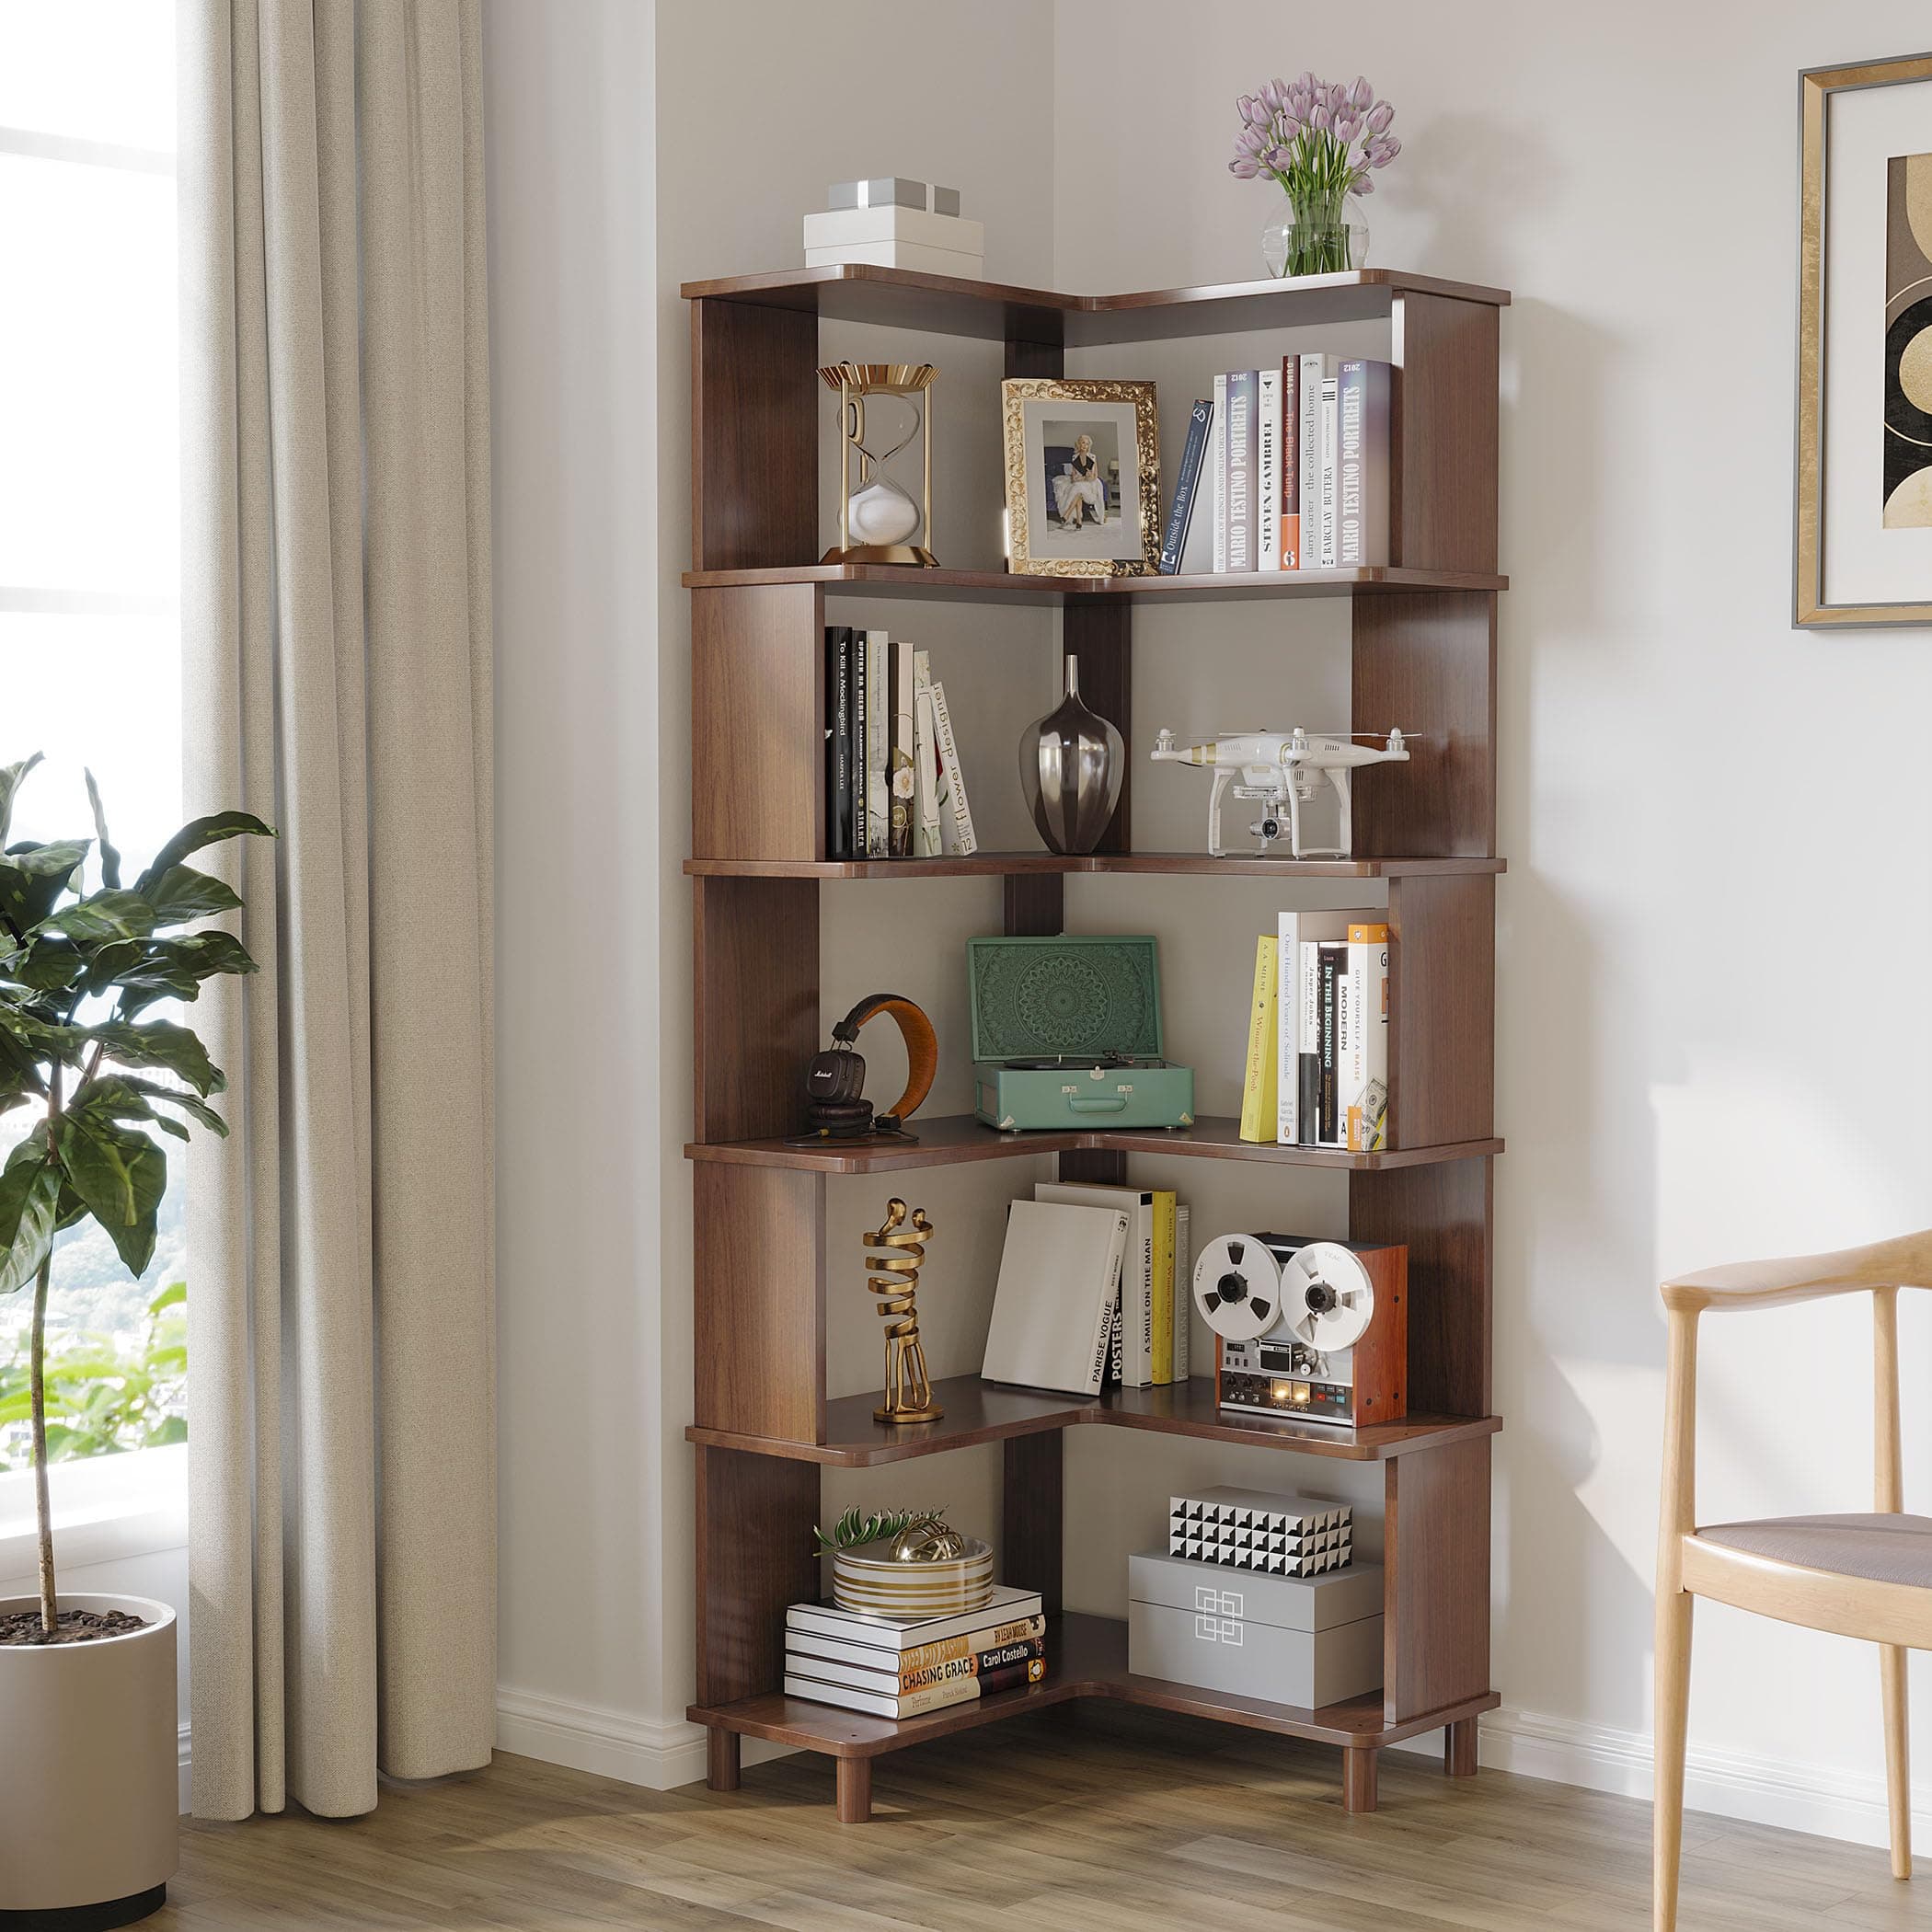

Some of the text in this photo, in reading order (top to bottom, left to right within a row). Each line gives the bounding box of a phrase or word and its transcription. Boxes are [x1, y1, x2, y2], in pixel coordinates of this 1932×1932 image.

[1283, 411, 1294, 499] The Black Tulip
[1305, 385, 1316, 490] the collected home
[1176, 485, 1188, 501] Box
[1231, 471, 1247, 522] TESTINO
[1263, 419, 1272, 552] STEVEN GAMBREL
[1324, 466, 1332, 506] BUTERA
[1342, 464, 1360, 516] TESTINO
[1173, 503, 1183, 517] the
[1305, 500, 1316, 558] darryl carter
[1166, 520, 1181, 551] Outside
[1230, 526, 1247, 568] MARIO
[1324, 511, 1332, 554] BARCLAY
[1342, 519, 1359, 563] MARIO
[840, 641, 846, 653] To
[838, 679, 847, 736] Mockingbird
[933, 684, 954, 758] designer
[949, 765, 967, 821] flower
[962, 838, 972, 851] 12
[1325, 966, 1333, 979] IN
[1325, 981, 1333, 1004] THE
[1250, 1015, 1263, 1092] Winnie-the-Pooh
[1284, 1028, 1291, 1039] of
[1325, 1006, 1333, 1067] BEGINNING
[1195, 1261, 1205, 1282] TEAC
[1144, 1292, 1151, 1307] ON
[1092, 1300, 1112, 1383] PARISE VOGUE
[1179, 1316, 1187, 1332] ON
[1111, 1312, 1122, 1381] POSTERS
[903, 1657, 974, 1690] CHASING GRACE
[983, 1645, 1029, 1668] Carol Costello
